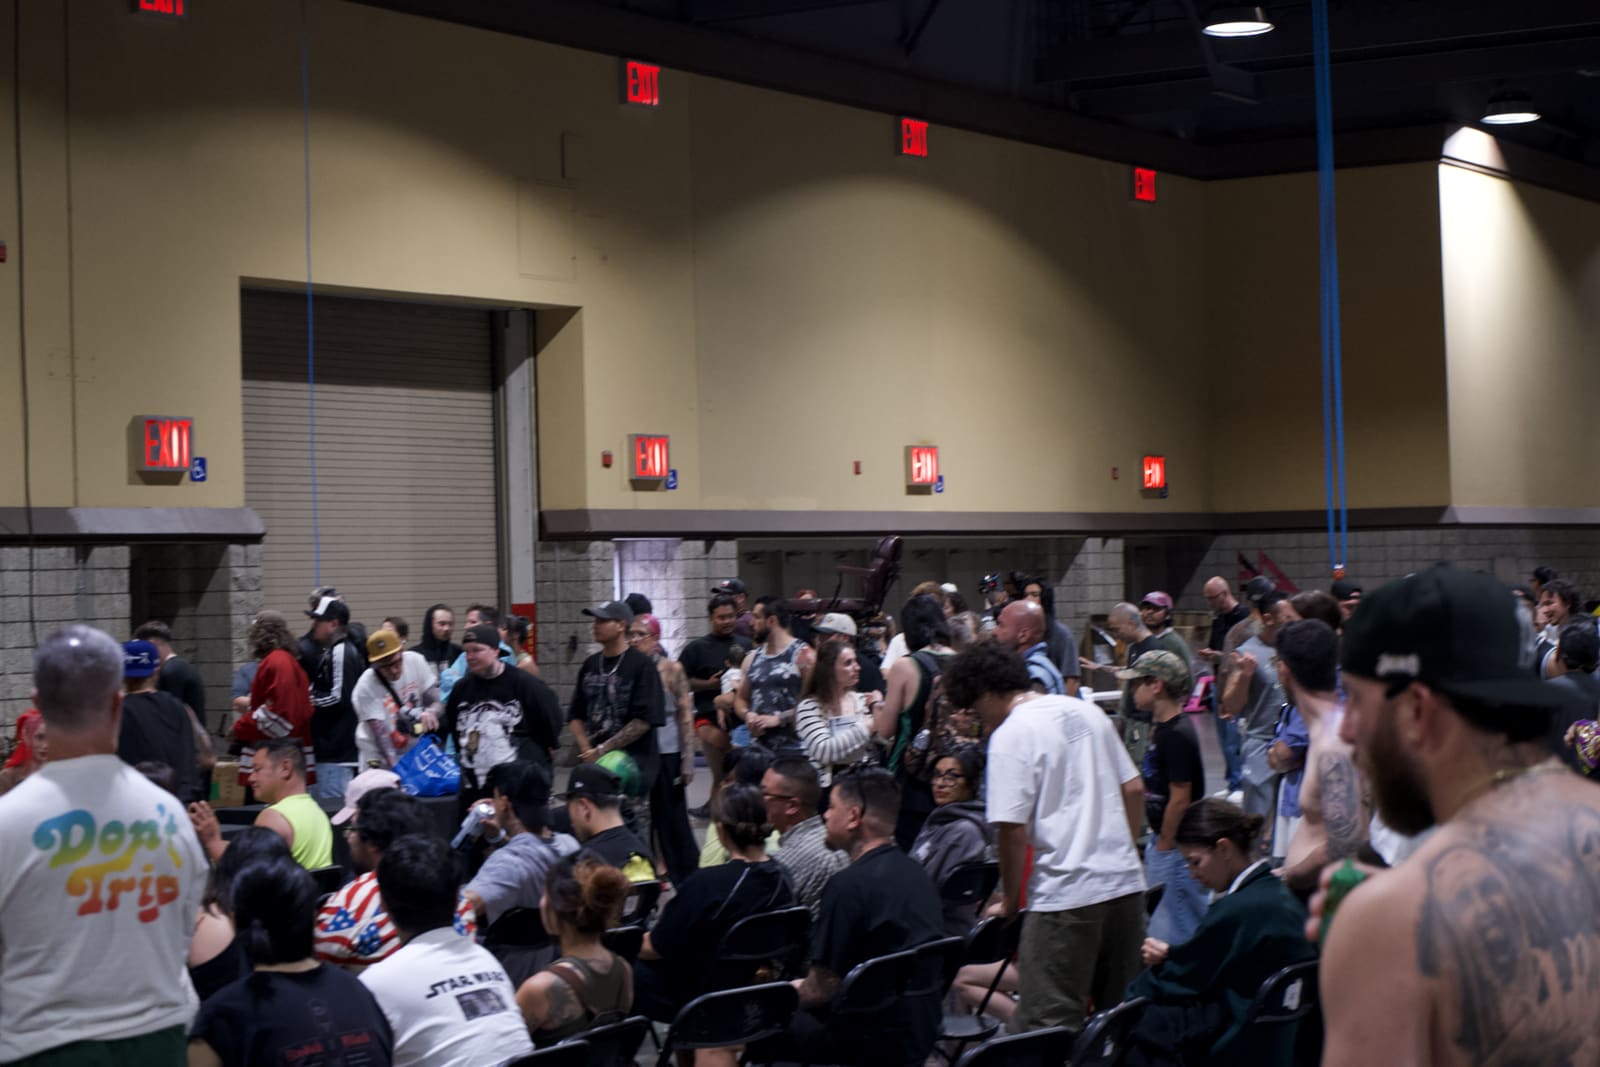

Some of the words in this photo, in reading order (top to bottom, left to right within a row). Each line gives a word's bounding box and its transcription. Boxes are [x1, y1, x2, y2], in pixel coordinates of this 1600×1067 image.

[627, 61, 660, 106] EXIT
[144, 418, 192, 468] EXIT
[635, 436, 669, 477] EXIT
[33, 803, 183, 869] Don't
[66, 846, 180, 923] Trip
[425, 975, 473, 999] STAR
